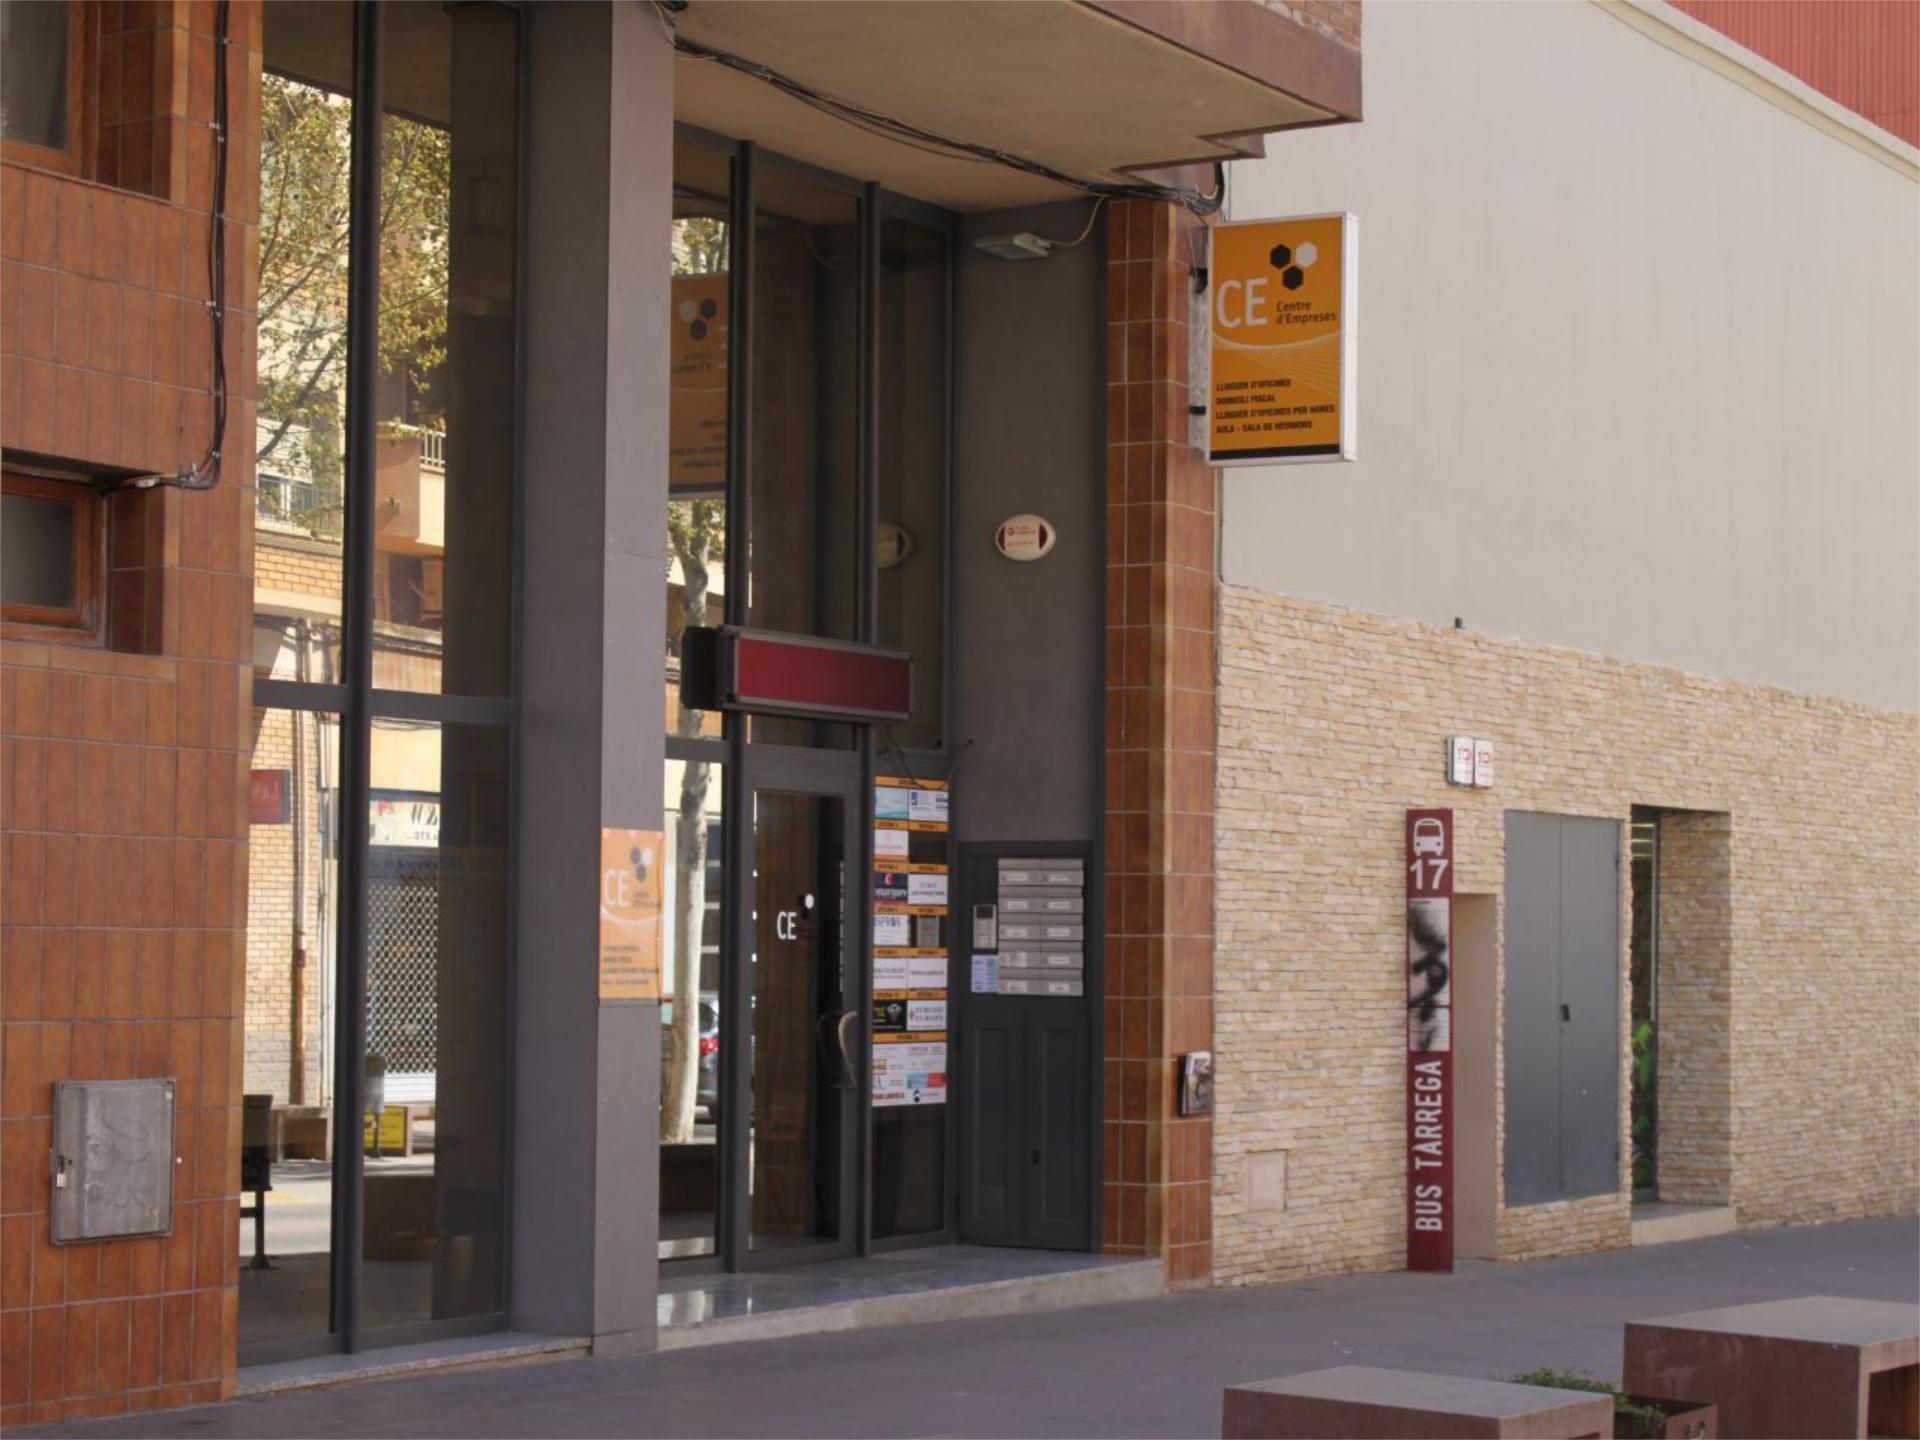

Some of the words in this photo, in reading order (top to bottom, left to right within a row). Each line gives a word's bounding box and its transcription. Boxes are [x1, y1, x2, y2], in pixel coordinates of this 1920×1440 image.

[1216, 277, 1268, 328] CE
[1276, 301, 1311, 312] Centre
[1276, 313, 1336, 325] d'Empreses
[1216, 381, 1248, 391] LLOGUER
[1250, 394, 1275, 403] FISCAL
[1216, 409, 1248, 419] LLOGUER
[1293, 406, 1308, 415] PER
[1309, 404, 1335, 413] HORES
[1216, 424, 1235, 433] AULA
[1242, 422, 1261, 432] SALA
[1263, 421, 1272, 431] DE
[1274, 420, 1312, 430] REUNIONS
[1410, 859, 1448, 890] 17
[605, 868, 631, 908] CE
[776, 910, 797, 940] CE
[1411, 1060, 1443, 1170] TÀRREGA
[1415, 1184, 1443, 1232] BUS
